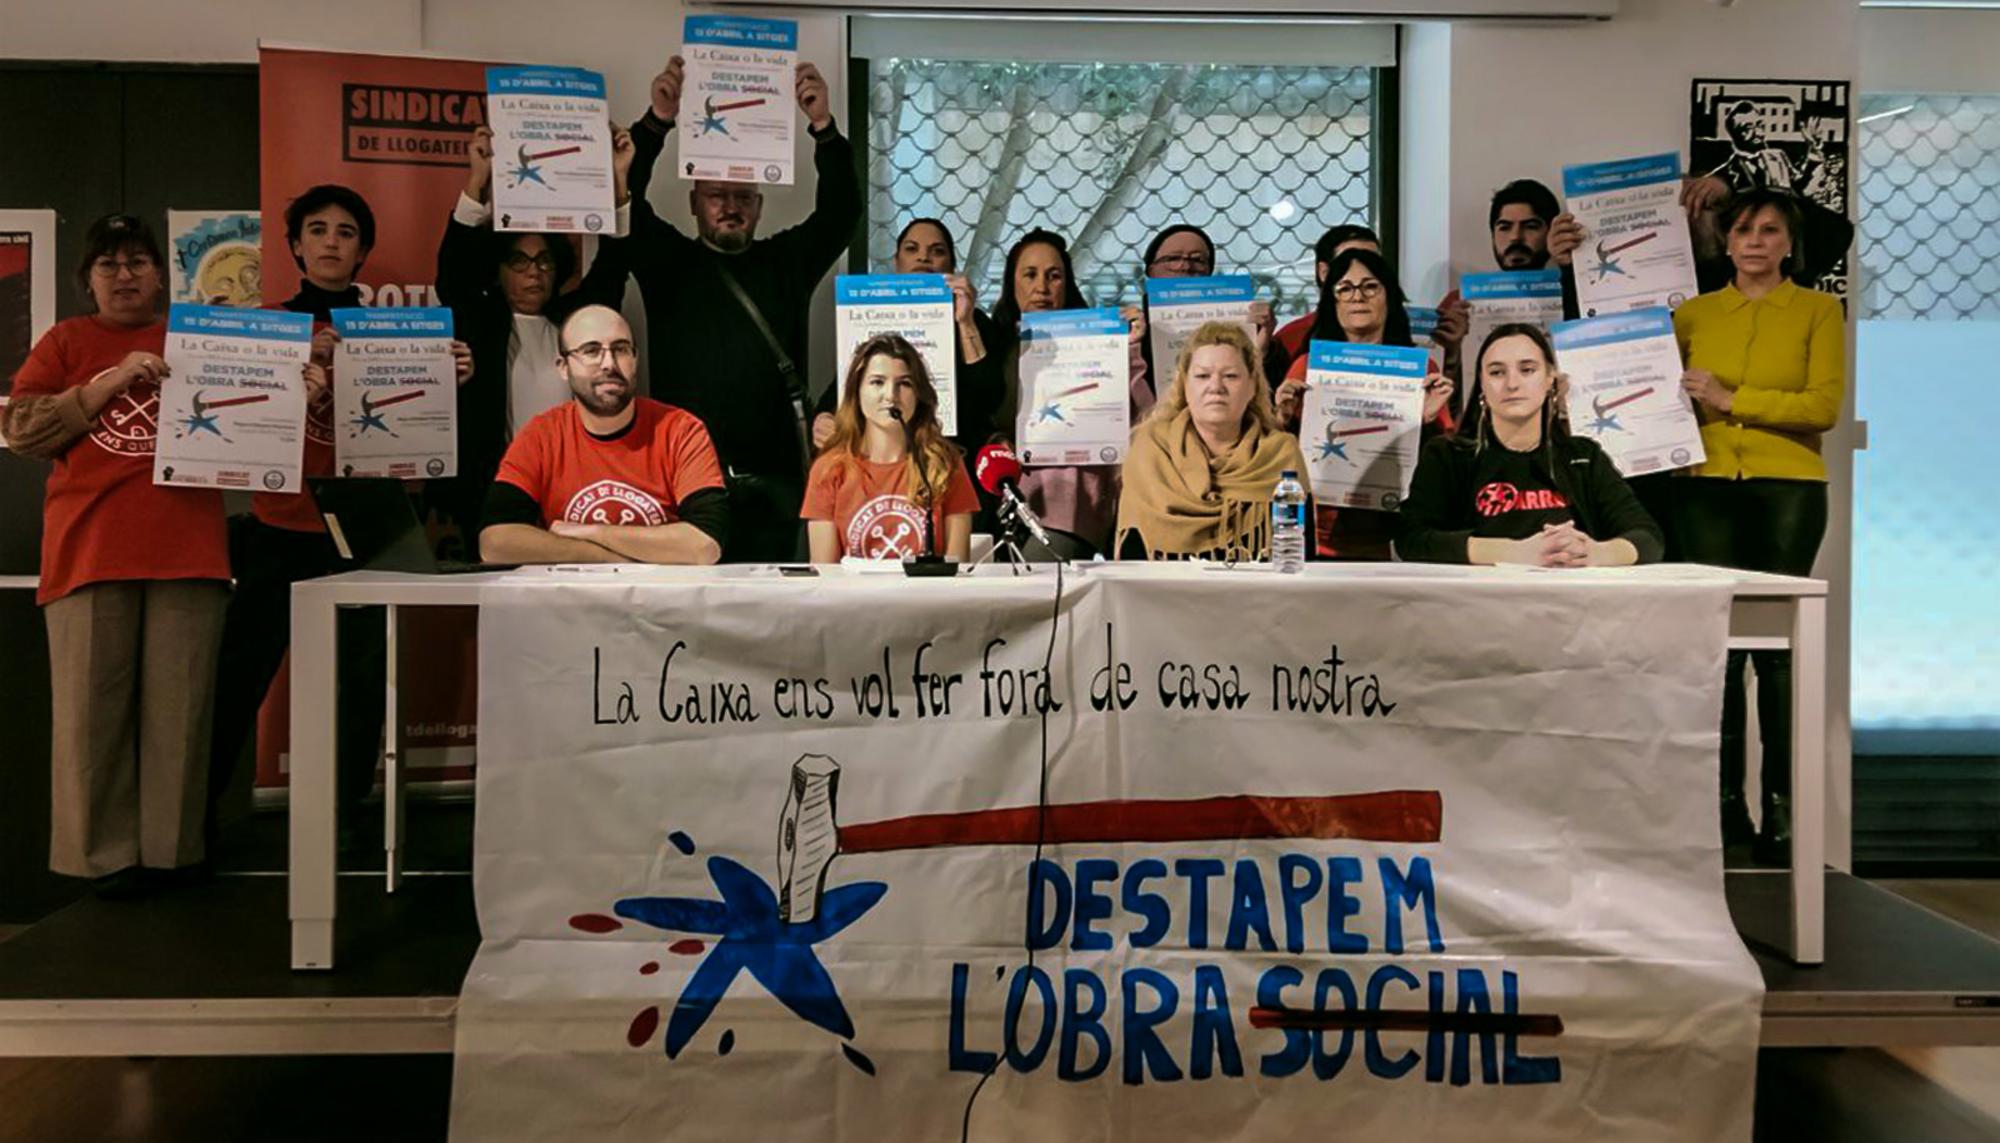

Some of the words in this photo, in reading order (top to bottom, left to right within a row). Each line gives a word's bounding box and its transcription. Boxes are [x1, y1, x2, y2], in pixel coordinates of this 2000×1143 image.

[352, 88, 487, 126] SINDICA
[358, 135, 380, 150] DE
[202, 340, 240, 354] Caixa
[272, 346, 299, 358] vida
[364, 343, 396, 354] Caixa
[422, 343, 446, 354] vida
[202, 364, 274, 377] DESTAPEM
[367, 366, 427, 375] DESTAPEM
[186, 376, 234, 388] L'OBRA
[239, 380, 288, 391] SOCIAL
[353, 376, 397, 386] L'OBRA
[399, 377, 441, 386] SOCIAL
[97, 431, 122, 448] ENS
[598, 486, 610, 497] DE
[594, 645, 639, 724] La
[659, 640, 760, 724] Caixa
[774, 676, 834, 720] ens
[851, 646, 900, 719] vol
[912, 641, 963, 719] fer
[980, 638, 1063, 717] fora
[1090, 622, 1138, 712] de
[1158, 660, 1250, 712] casa
[1272, 644, 1398, 718] nostra
[1026, 854, 1446, 955] DESTAPEM
[948, 962, 1244, 1086] L'OBRA
[1254, 964, 1564, 1087] SOCIAL
